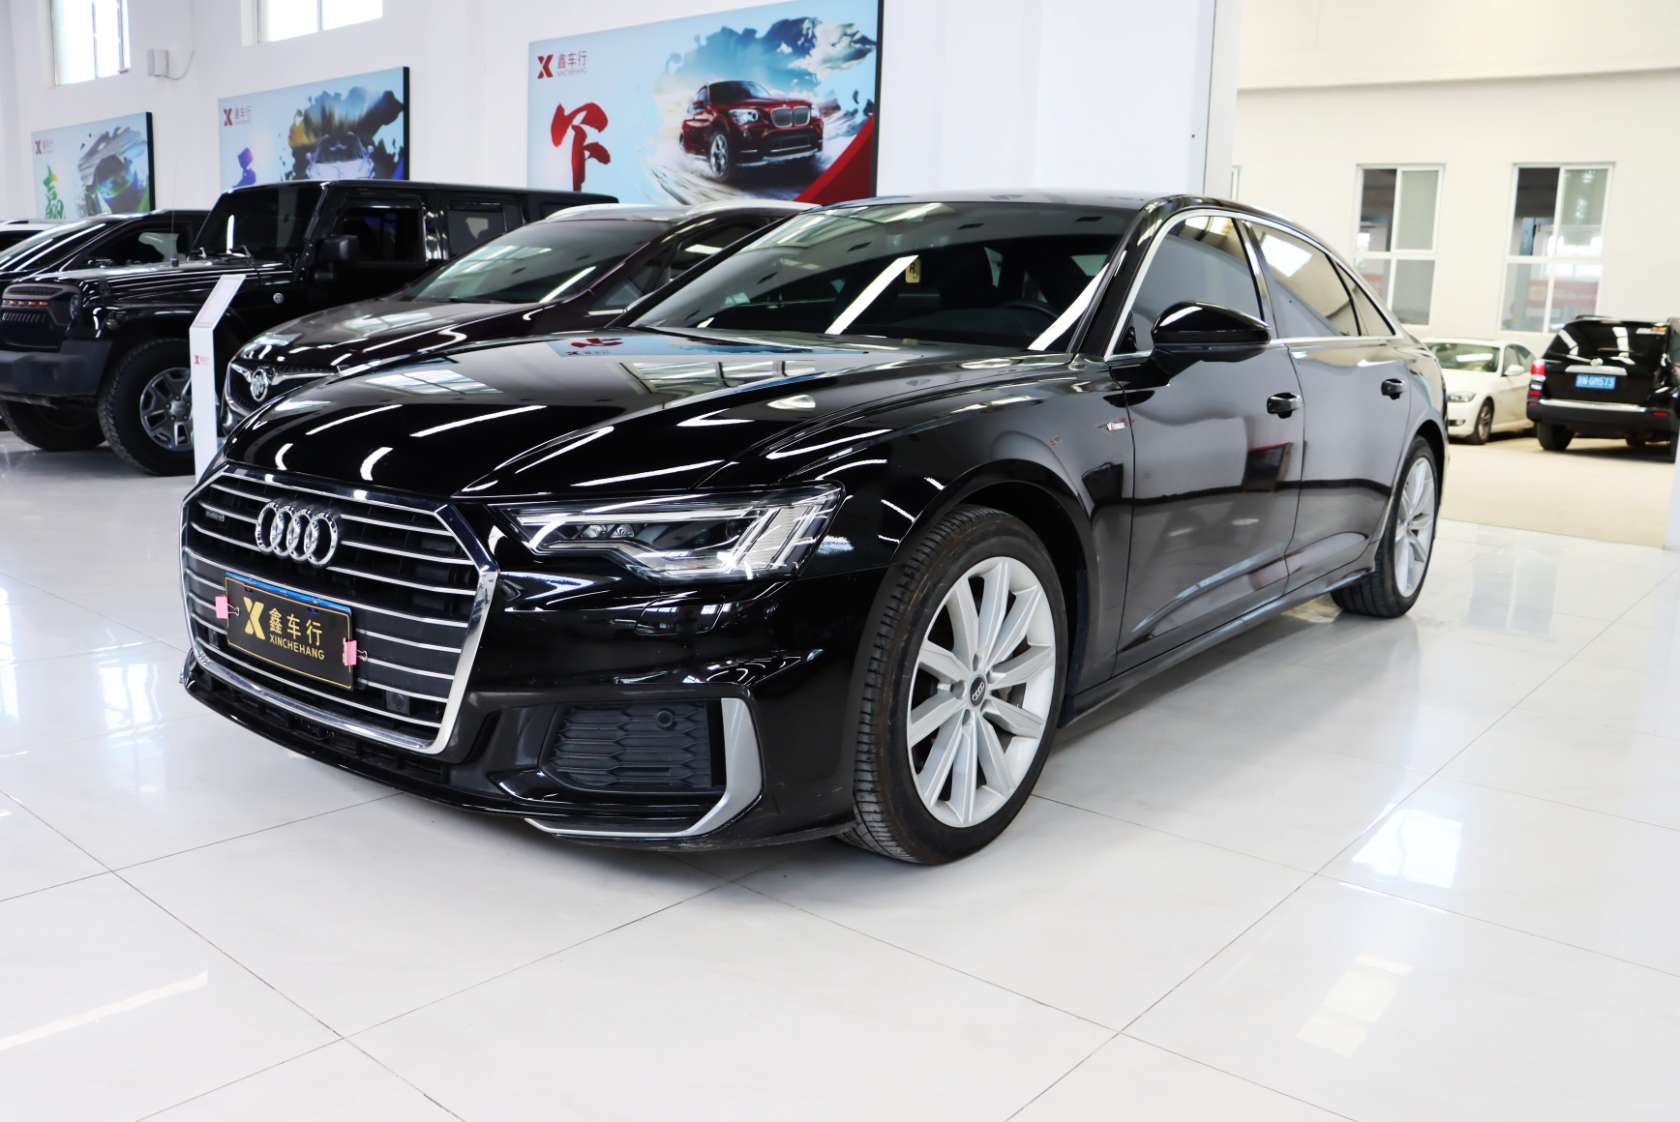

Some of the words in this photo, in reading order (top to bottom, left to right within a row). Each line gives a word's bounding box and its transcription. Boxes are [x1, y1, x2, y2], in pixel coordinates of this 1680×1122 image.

[268, 607, 322, 646] 鑫车行
[269, 633, 325, 660] XINCHEHANG
